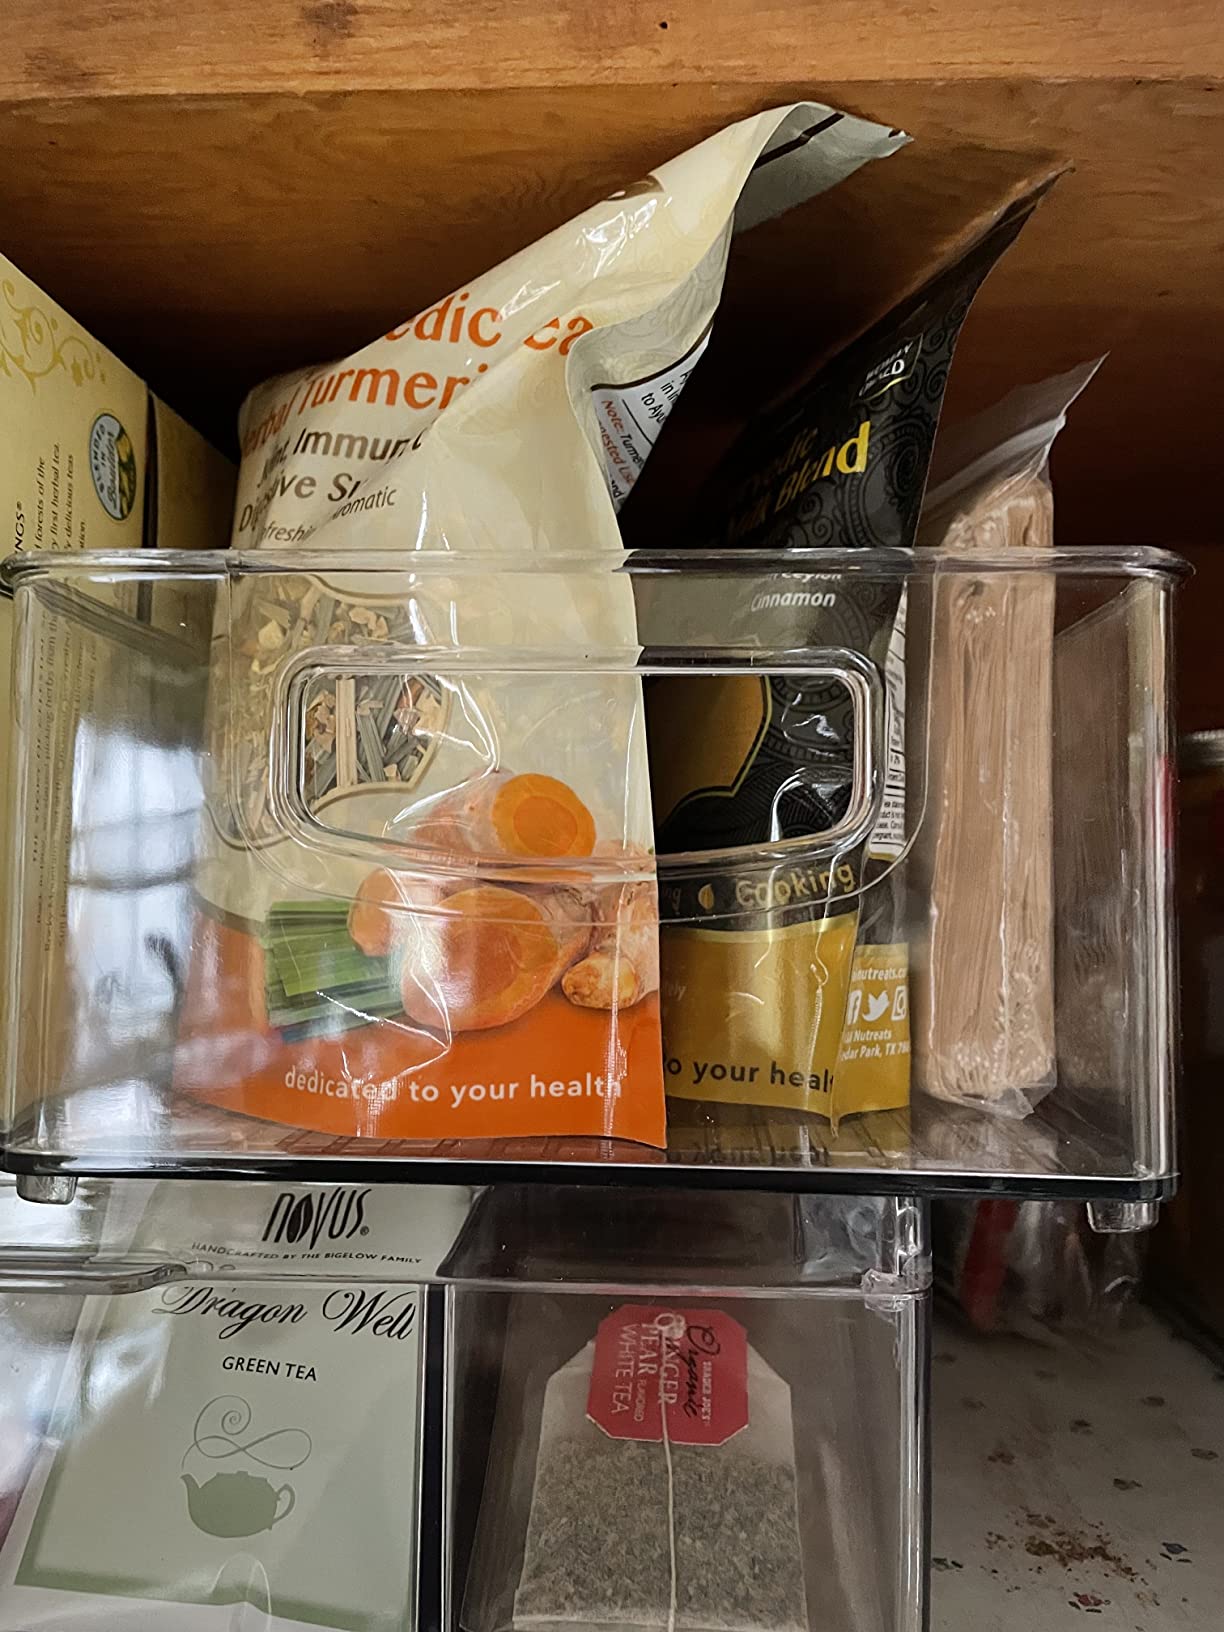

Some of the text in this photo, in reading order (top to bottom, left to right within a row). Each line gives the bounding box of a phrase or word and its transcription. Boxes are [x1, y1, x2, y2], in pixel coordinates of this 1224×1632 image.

[64, 482, 74, 538] delicious
[750, 591, 837, 612] Cinnamon
[735, 862, 856, 907] Cooking
[284, 1064, 624, 1109] dedicated to your health
[692, 1057, 760, 1085] your
[191, 1241, 280, 1260] HANDCRAFTED
[324, 1251, 378, 1261] BIGELOW
[380, 1253, 423, 1265] FAMILY
[151, 1285, 417, 1341] Dragon Well
[221, 1355, 318, 1382] GREEN TEA
[610, 1322, 640, 1415] WHITE TEA
